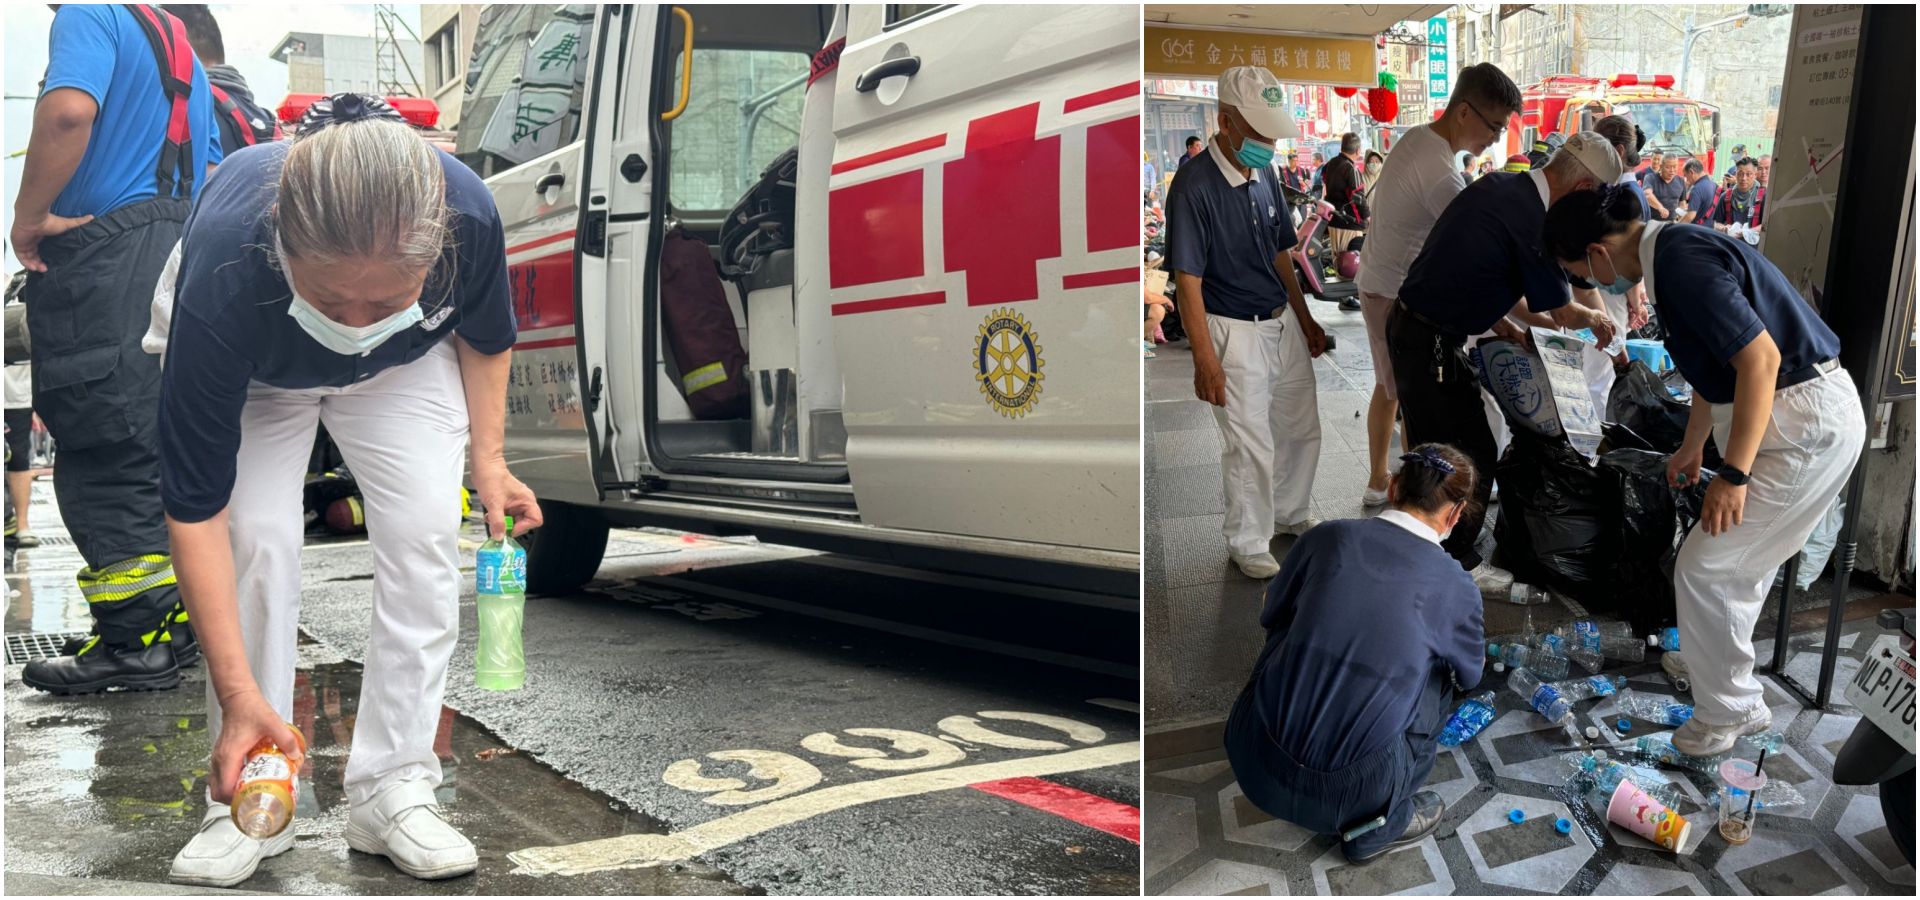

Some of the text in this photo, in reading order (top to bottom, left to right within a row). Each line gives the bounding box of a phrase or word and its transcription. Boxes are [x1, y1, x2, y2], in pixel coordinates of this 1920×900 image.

[1205, 42, 1352, 71] 金六福珠寶銀樓
[1429, 21, 1447, 93] 小林眼鏡
[990, 319, 1019, 332] ROTARY
[986, 381, 1034, 408] INTERNATIONAL
[661, 710, 1106, 806] 990
